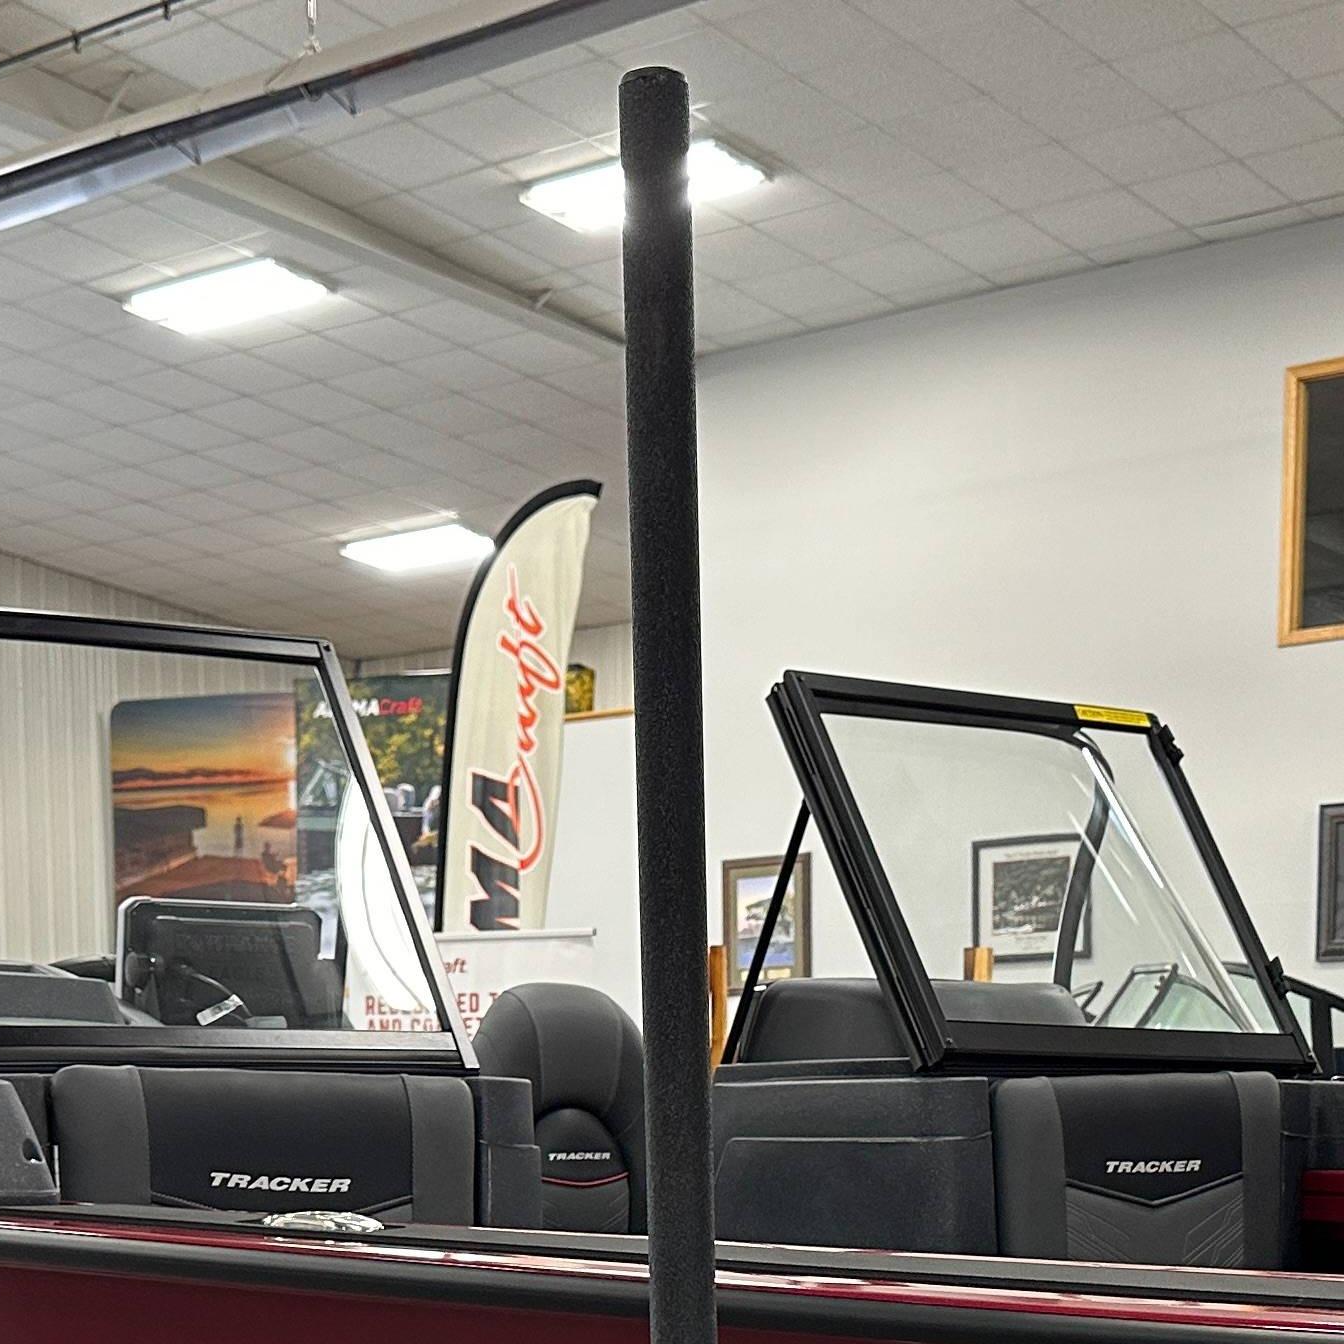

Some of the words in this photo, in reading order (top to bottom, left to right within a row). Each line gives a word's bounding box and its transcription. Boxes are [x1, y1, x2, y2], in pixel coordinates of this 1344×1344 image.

[548, 1151, 612, 1162] TRACKER
[1106, 1159, 1202, 1174] TRACKER
[209, 1171, 352, 1194] TRACKER
